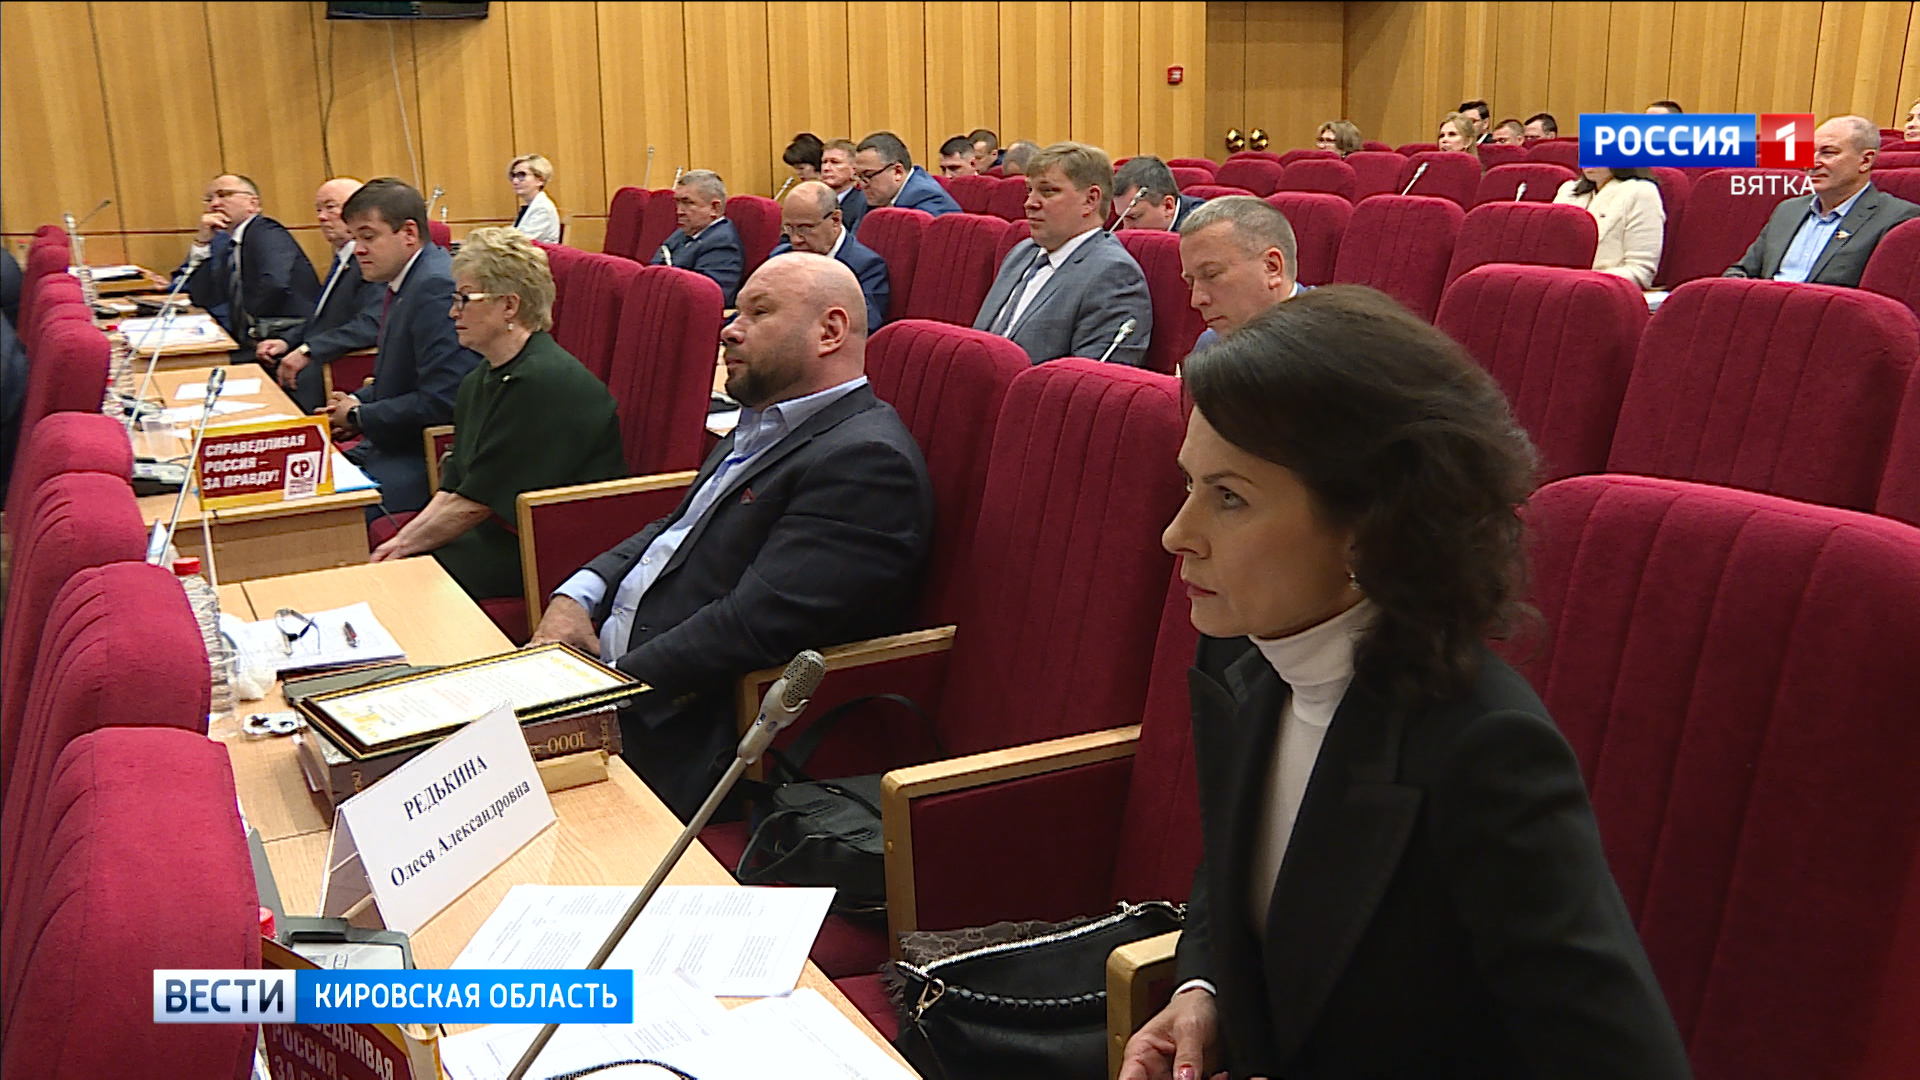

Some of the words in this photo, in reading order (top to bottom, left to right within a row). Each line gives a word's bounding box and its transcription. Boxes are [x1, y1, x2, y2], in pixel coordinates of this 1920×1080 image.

[205, 434, 306, 457] СПРАВЕДЛИВАЯ
[204, 457, 257, 473] РОССИЯ
[202, 474, 220, 490] ЗА
[223, 469, 280, 488] ПРАВДУ!
[547, 730, 586, 754] 1000
[403, 755, 488, 821] РЕДЬКИНА
[390, 849, 436, 887] Олеся
[440, 780, 531, 856] Александровна
[312, 1024, 394, 1080] ЕДЛИВАЯ
